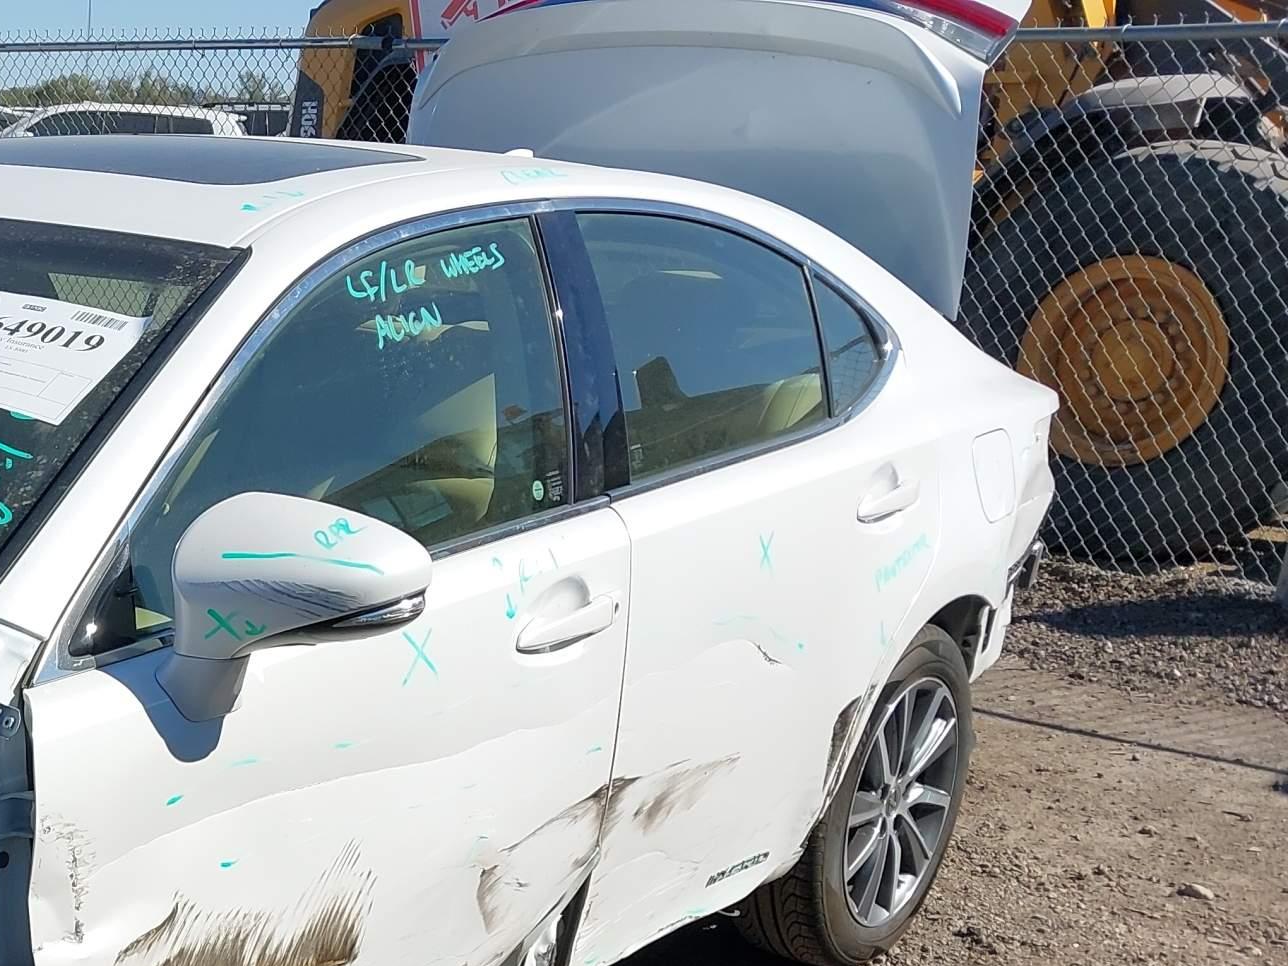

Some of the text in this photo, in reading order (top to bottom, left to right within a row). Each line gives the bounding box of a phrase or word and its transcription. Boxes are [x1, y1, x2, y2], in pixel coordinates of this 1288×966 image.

[440, 243, 505, 279] WHEELS
[5, 336, 46, 351] Insurance
[375, 302, 442, 349] ALIGN
